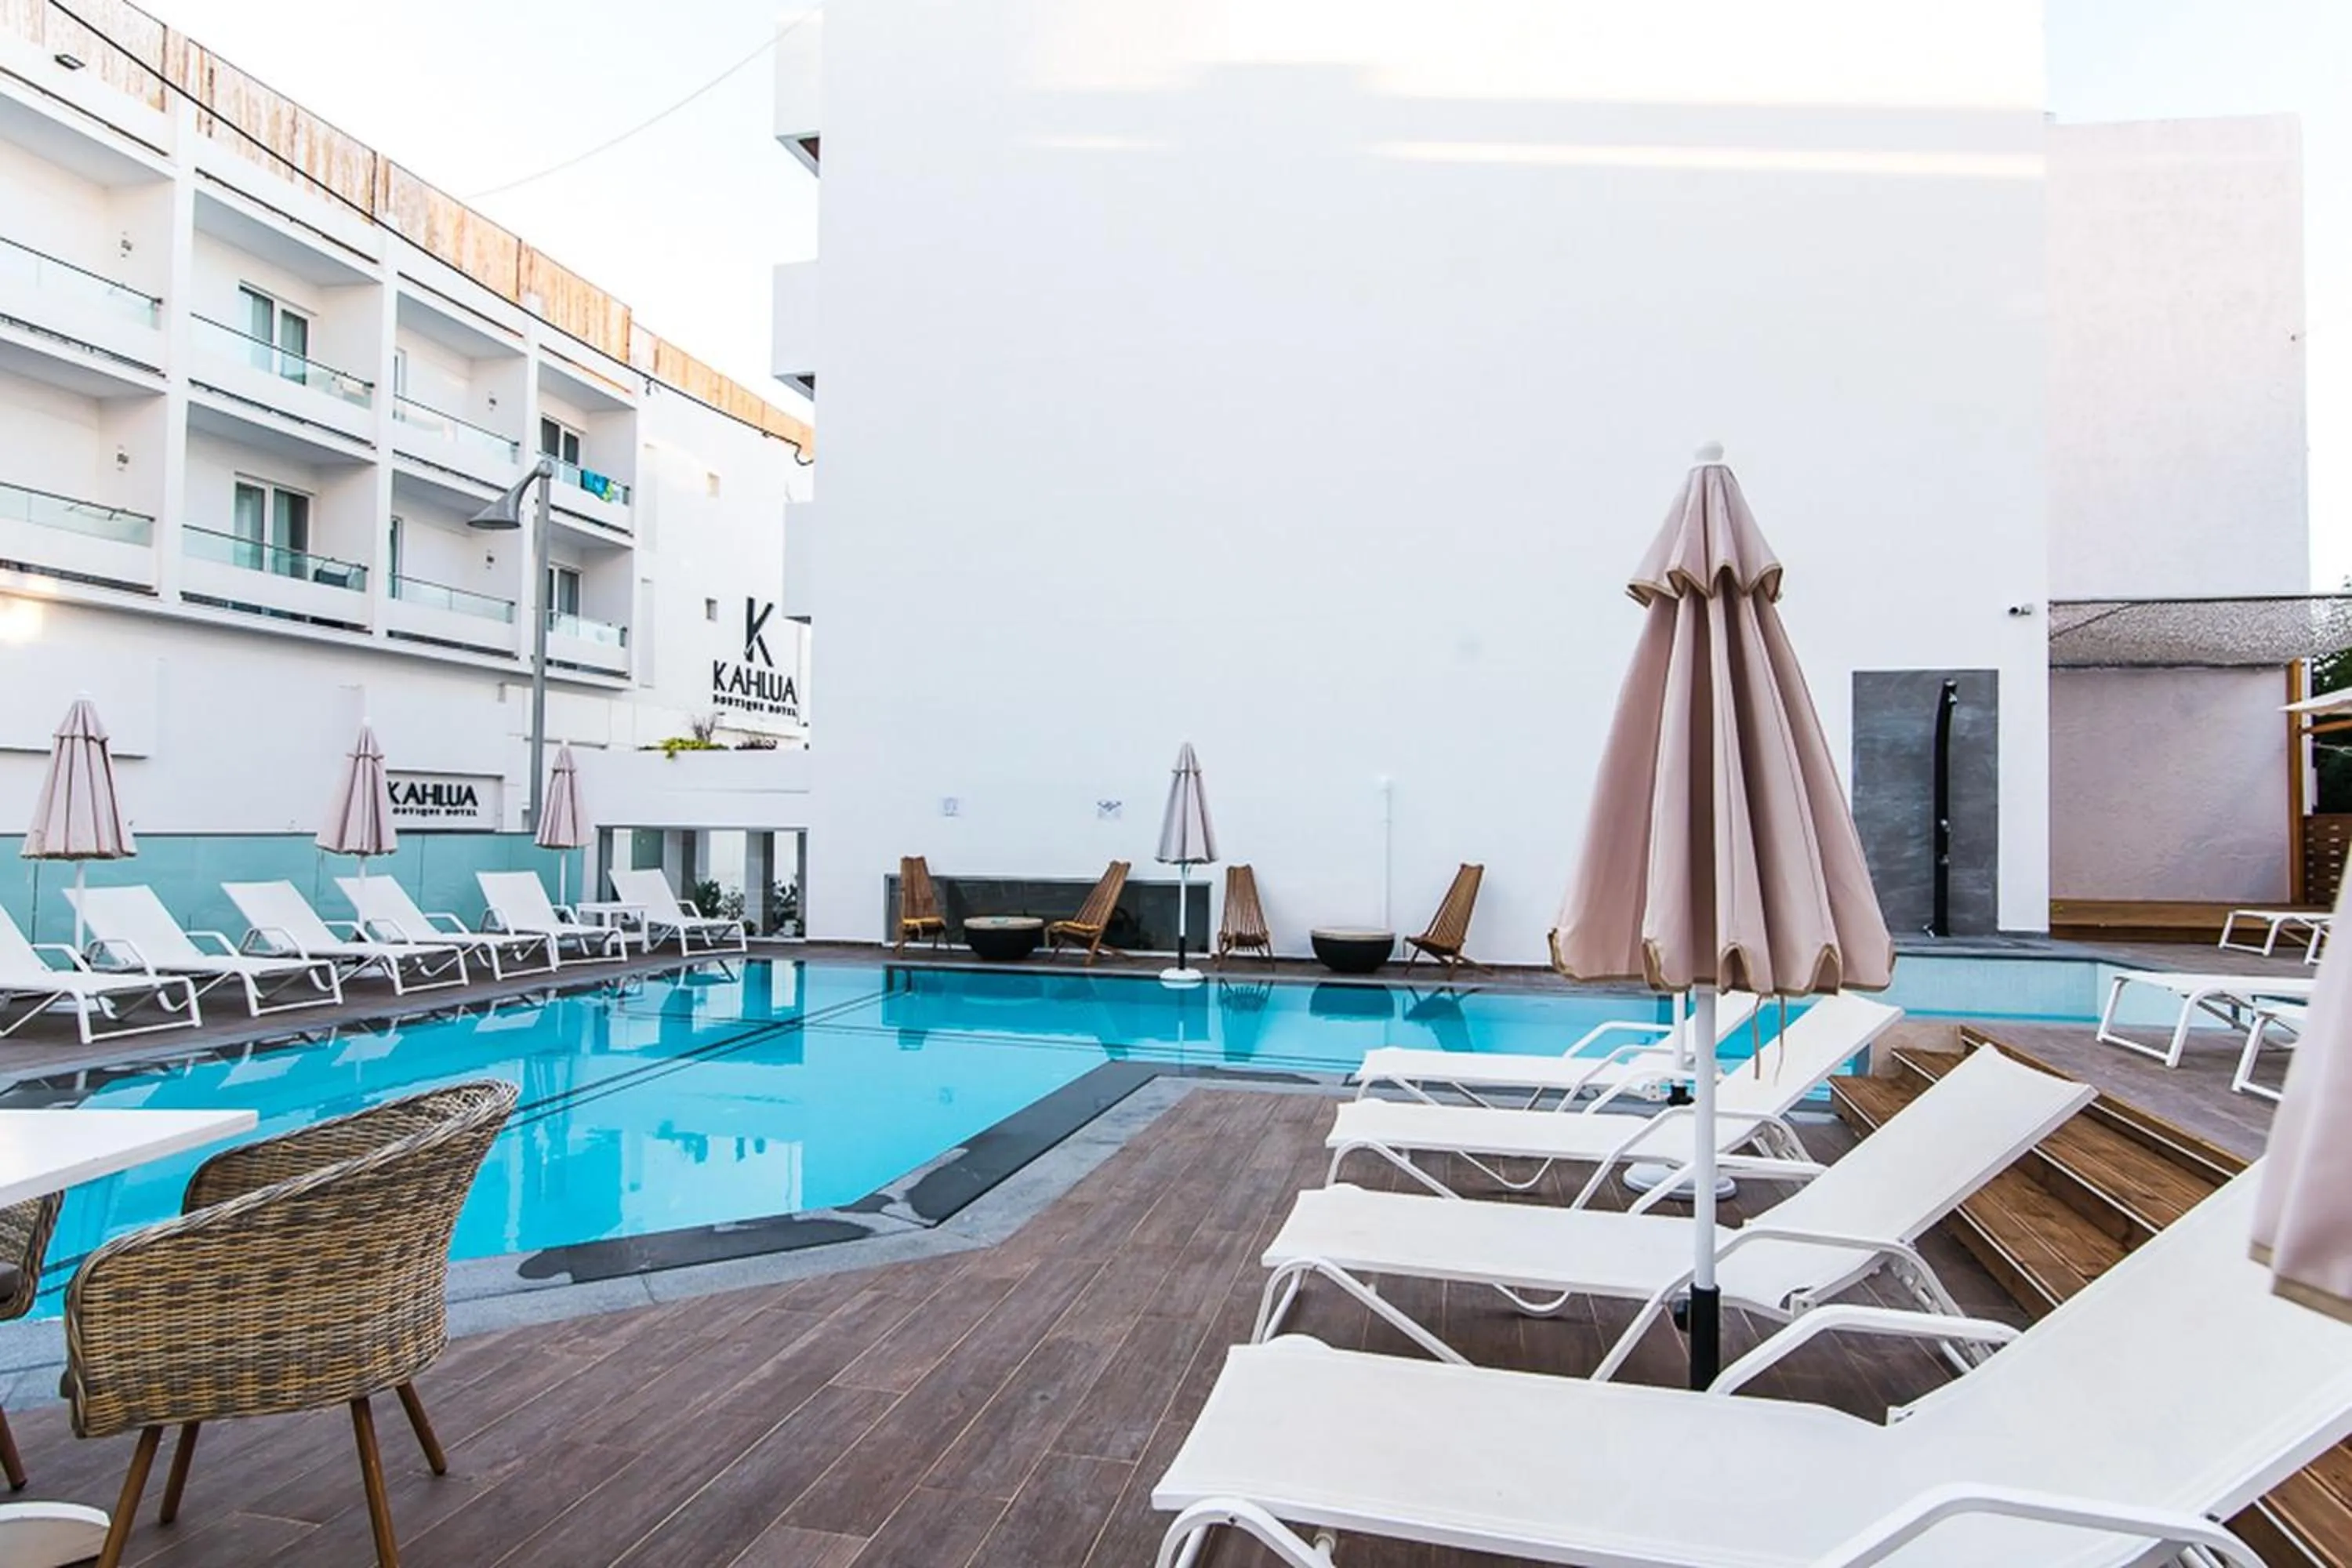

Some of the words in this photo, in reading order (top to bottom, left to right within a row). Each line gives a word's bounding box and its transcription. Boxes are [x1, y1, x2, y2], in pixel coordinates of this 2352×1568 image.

[744, 597, 775, 667] K
[713, 659, 798, 705] KAHLUA
[713, 694, 764, 712] BOUTIQUE
[768, 705, 797, 717] HOTEL
[392, 807, 440, 817] OUTIQUE
[445, 808, 477, 817] HOTEL
